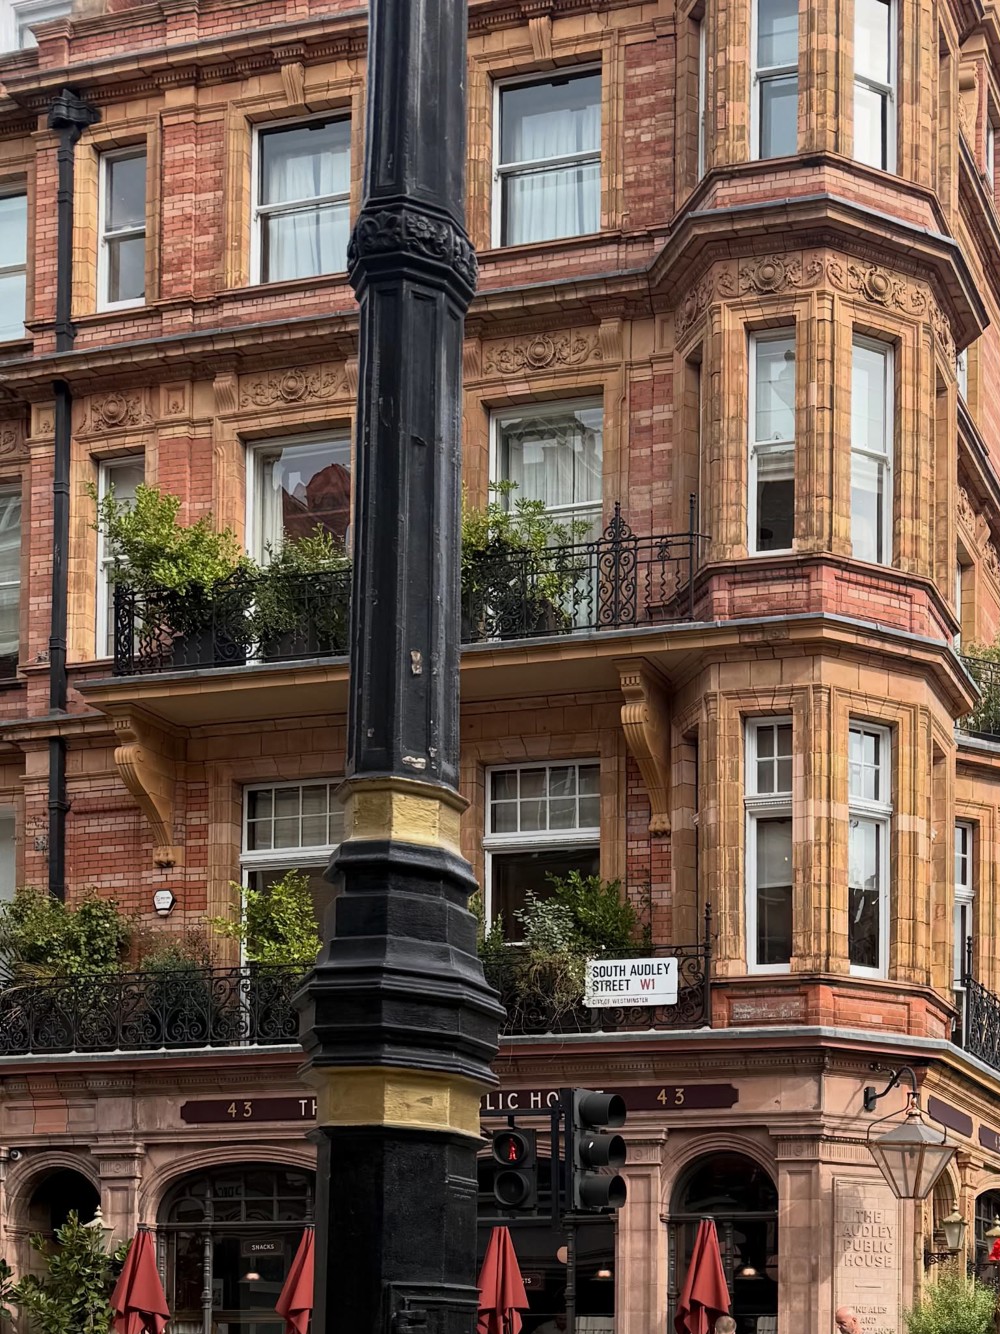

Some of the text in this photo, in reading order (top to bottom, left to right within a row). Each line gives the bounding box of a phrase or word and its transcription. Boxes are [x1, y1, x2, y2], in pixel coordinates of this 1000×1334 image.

[592, 963, 671, 978] SOUTH AUDLEY
[592, 979, 655, 992] STREET W1
[227, 1102, 252, 1118] 43
[299, 1099, 318, 1117] TH
[479, 1093, 519, 1110] LIC
[657, 1088, 685, 1105] 43
[856, 1210, 881, 1223] THE
[842, 1224, 893, 1238] AUDLEY
[251, 1243, 275, 1251] SNACKS
[843, 1239, 893, 1253] PUBLIC
[844, 1254, 892, 1268] HOUSE
[868, 1305, 887, 1314] ALES
[860, 1316, 876, 1325] AND
